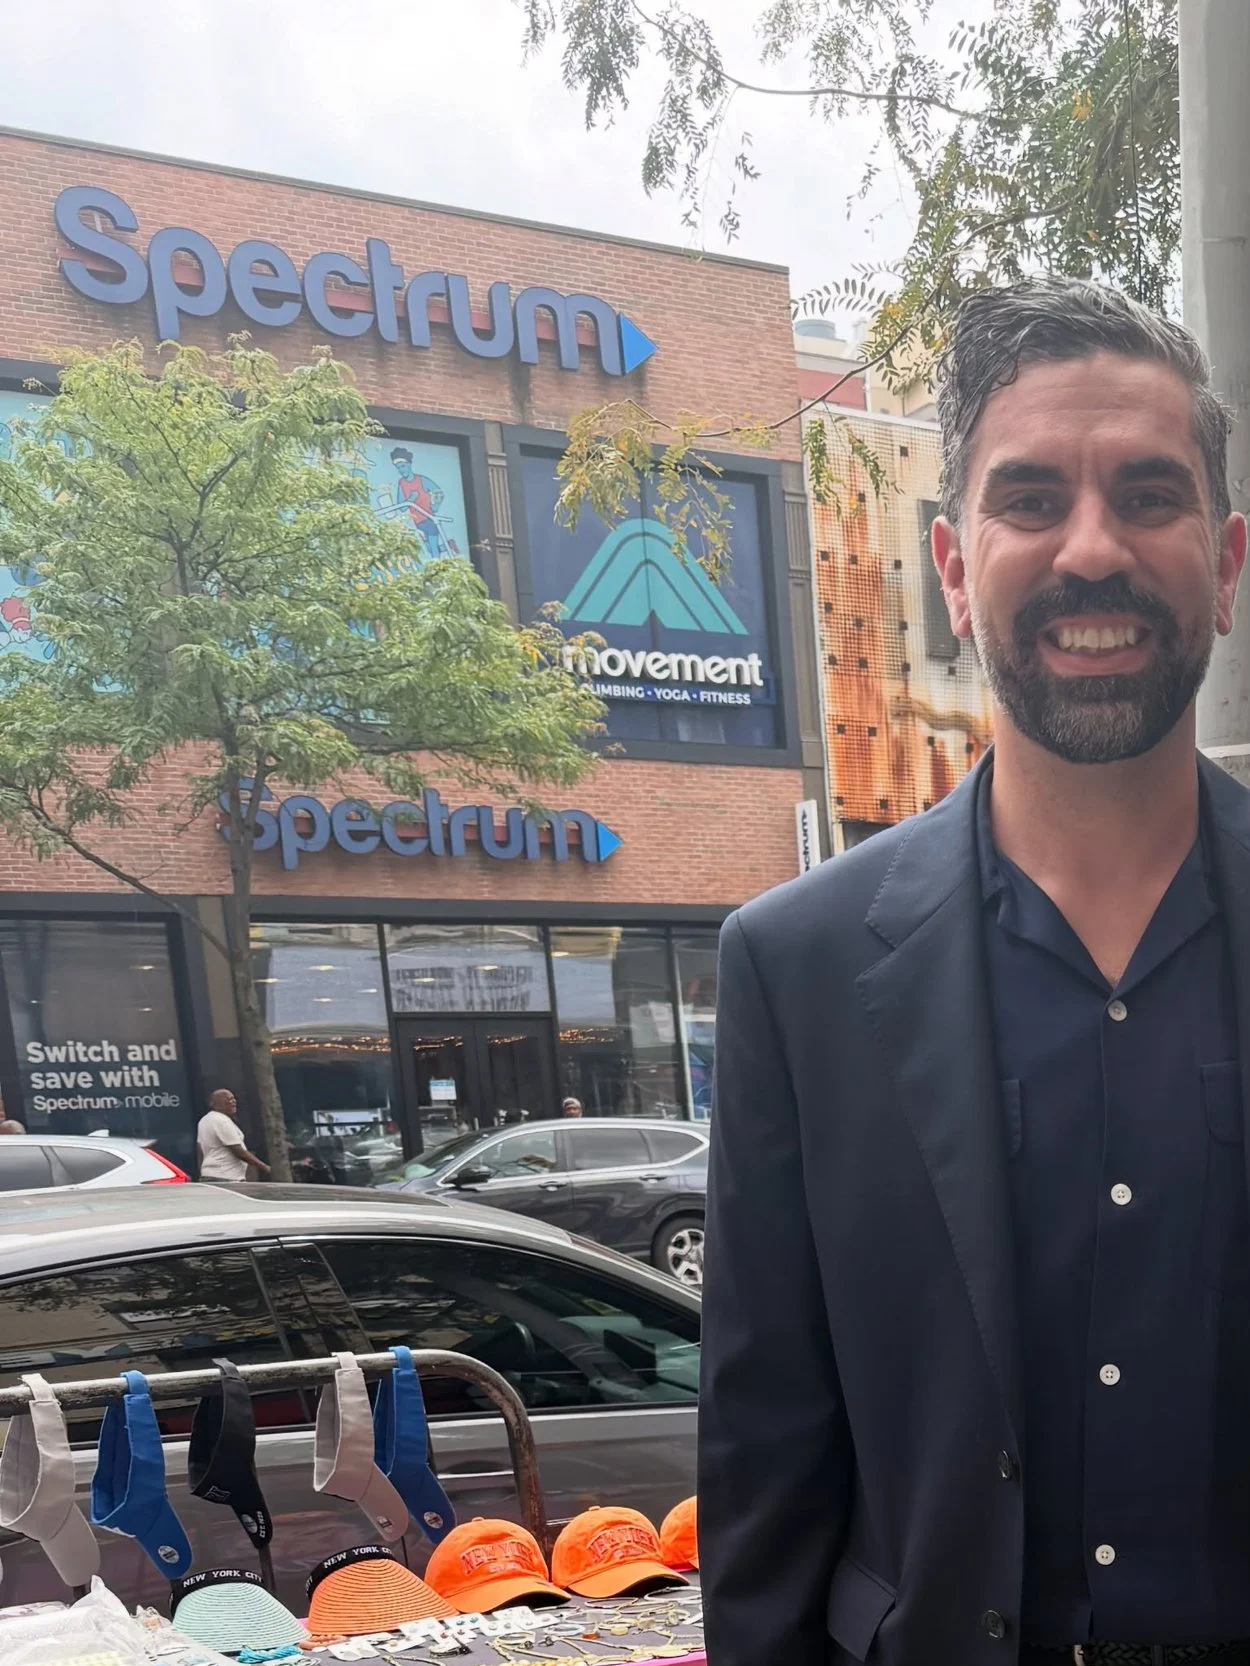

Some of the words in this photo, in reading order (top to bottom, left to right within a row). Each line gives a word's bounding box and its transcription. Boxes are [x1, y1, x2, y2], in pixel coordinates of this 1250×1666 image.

[54, 185, 624, 376] Spectrum
[561, 645, 764, 686] movement
[654, 688, 692, 701] YOGA
[700, 690, 752, 705] FITNESS
[26, 1040, 120, 1063] Switch
[127, 1039, 177, 1061] and
[30, 1071, 94, 1089] save
[100, 1065, 160, 1087] with
[33, 1094, 117, 1114] Spectrum
[125, 1092, 180, 1108] mobile
[323, 1552, 348, 1569] NEW
[352, 1546, 380, 1556] YORK
[183, 1573, 206, 1588] NEW
[212, 1569, 241, 1578] YORK
[245, 1571, 262, 1583] CITY
